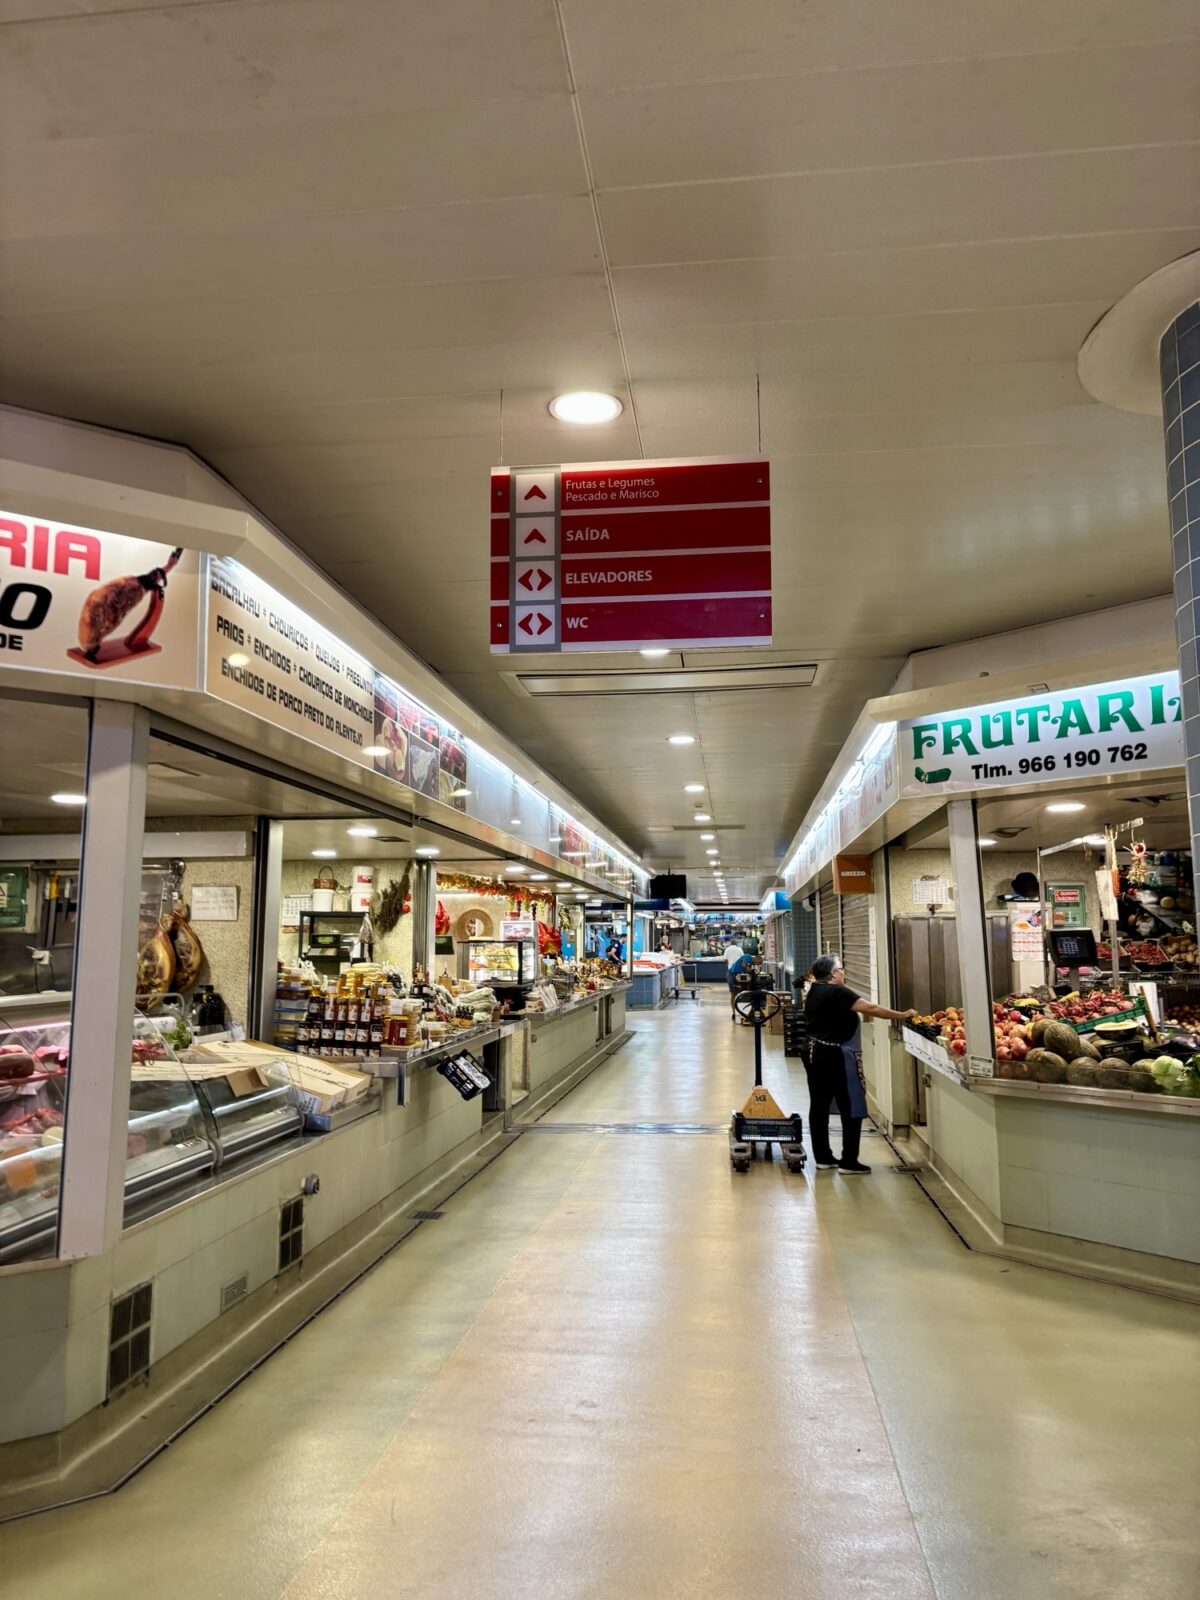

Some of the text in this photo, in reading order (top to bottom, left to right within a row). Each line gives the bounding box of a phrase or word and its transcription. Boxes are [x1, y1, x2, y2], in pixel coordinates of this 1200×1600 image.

[566, 476, 656, 490] Frutas e Legumes
[566, 489, 660, 502] Pescado e Marisco
[566, 527, 610, 542] SAÍDA
[566, 570, 653, 584] ELEVADORES
[566, 617, 589, 629] WC
[211, 573, 373, 696] BACALHAU CHOURIÇOS QUEIJOS PRESUNTO
[216, 615, 373, 724] PAIOS ENCHIDOS CHOURIÇOS DE MONCHIQUE
[222, 657, 363, 747] ENCHIDOS DE PORCO PRETO DO ALENTEJO
[971, 742, 1149, 780] Tlm. 966 190 762
